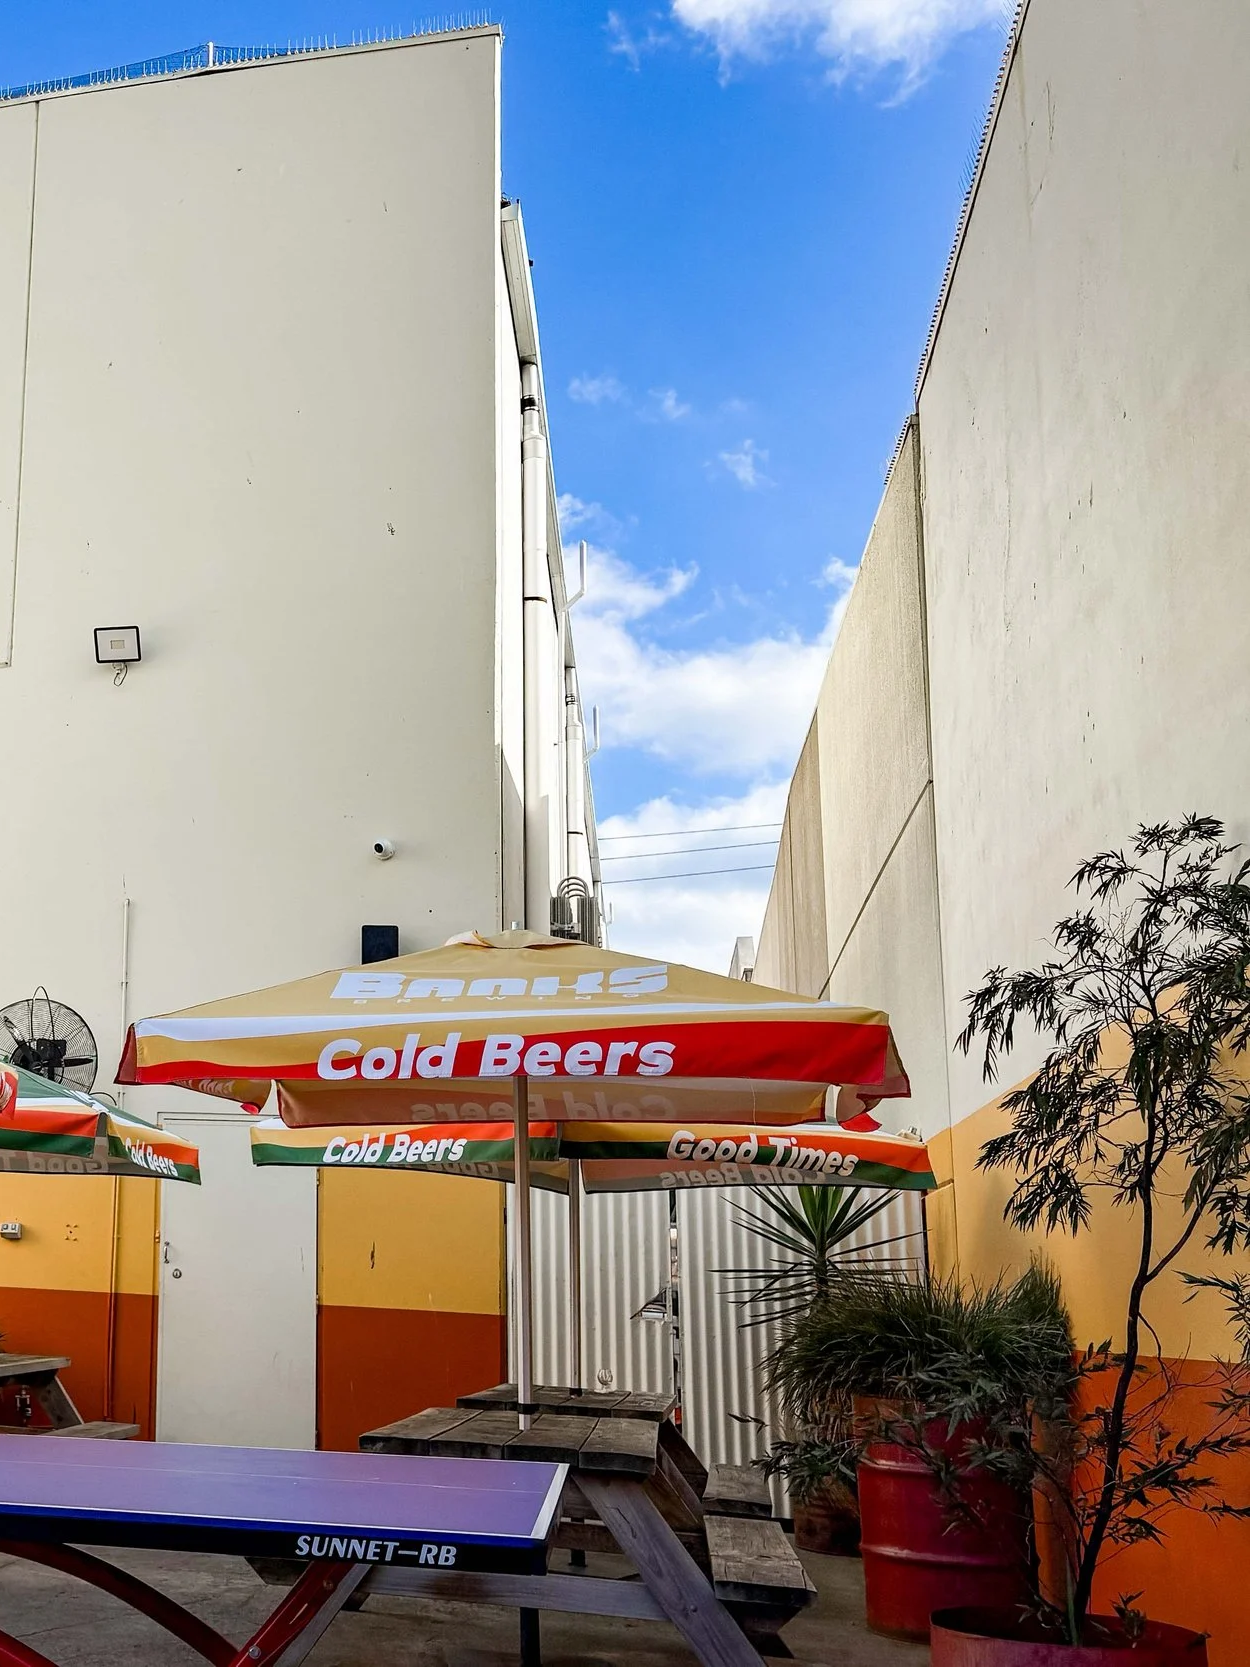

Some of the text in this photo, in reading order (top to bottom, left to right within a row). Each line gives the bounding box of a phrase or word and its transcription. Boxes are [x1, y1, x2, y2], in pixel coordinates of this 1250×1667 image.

[330, 964, 668, 999] BANKS
[317, 1032, 676, 1081] Cold Beers
[125, 1137, 178, 1177] Cold Beers
[322, 1133, 468, 1164] Cold Beers
[667, 1130, 859, 1177] Good Times
[294, 1535, 457, 1566] SUNNET-RB
